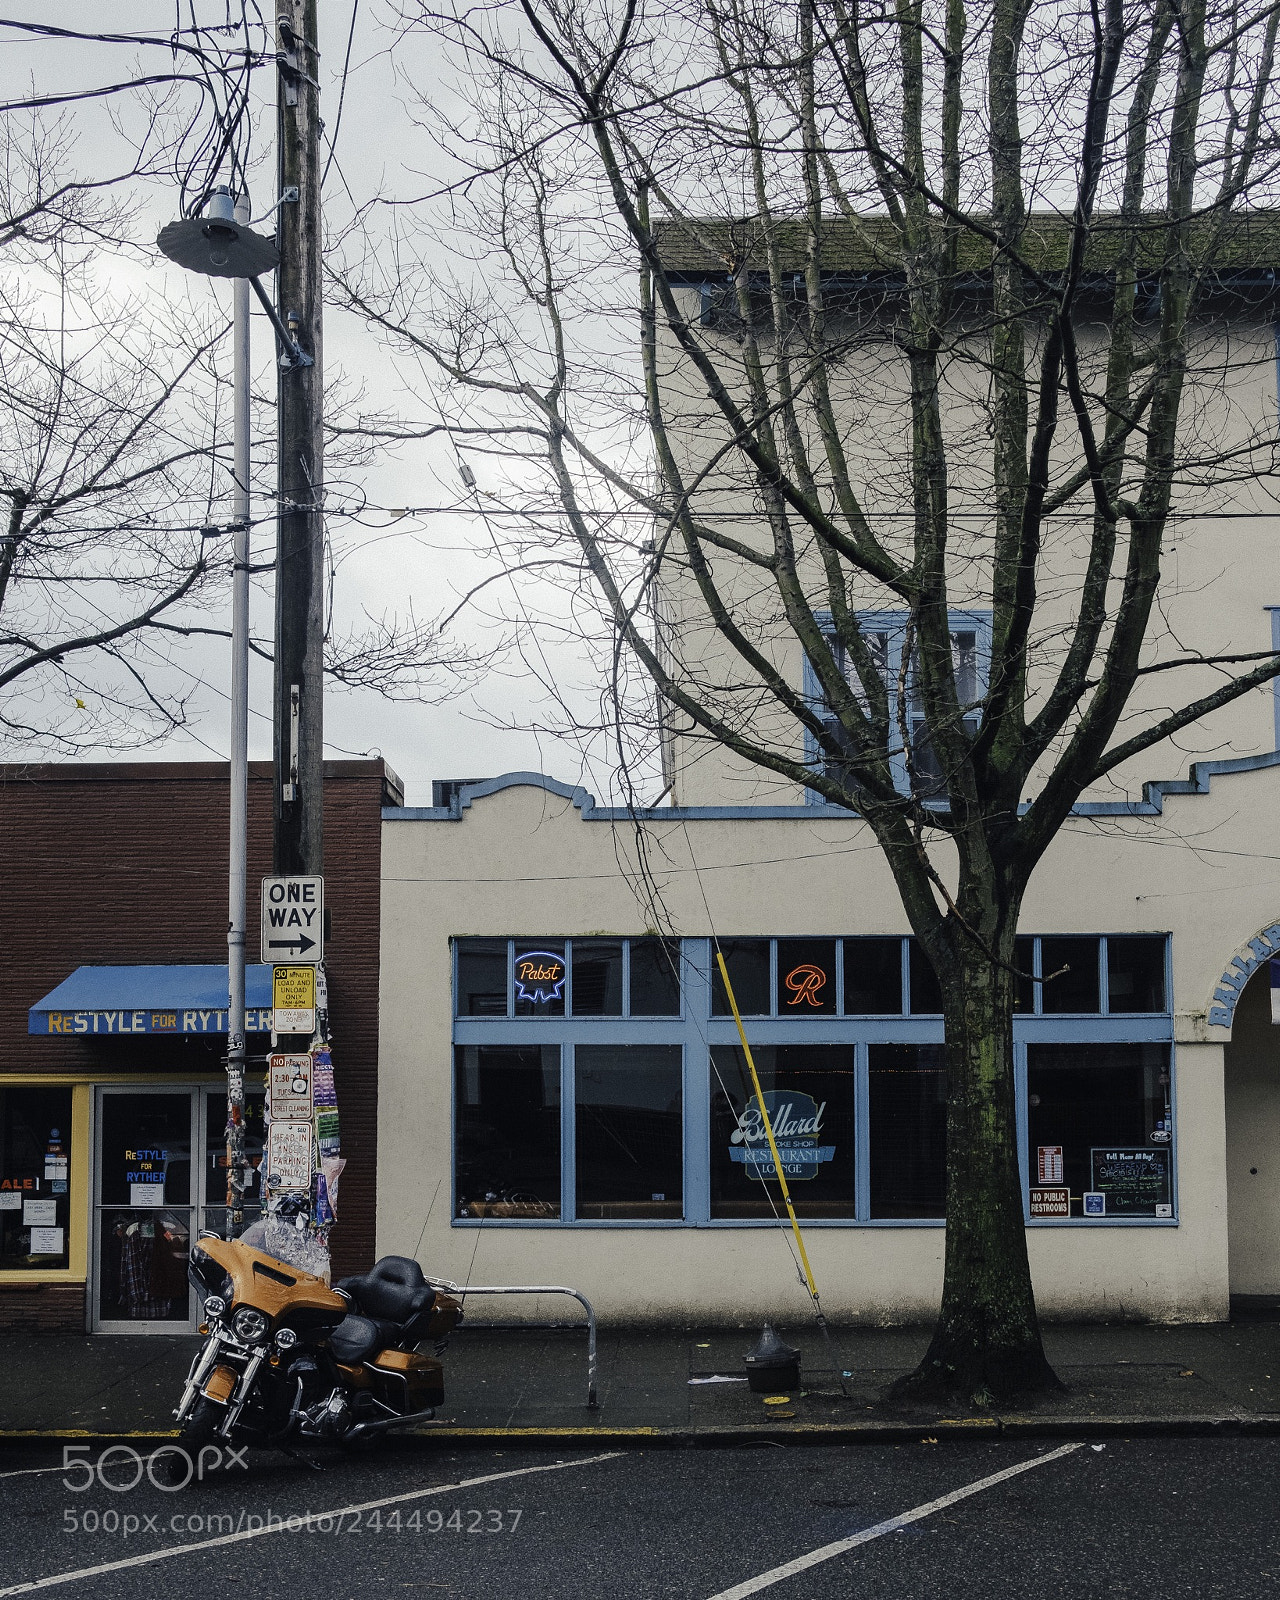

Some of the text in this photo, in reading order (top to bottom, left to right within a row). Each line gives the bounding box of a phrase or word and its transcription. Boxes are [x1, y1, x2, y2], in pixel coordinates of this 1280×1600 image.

[269, 883, 316, 903] ONE
[268, 908, 317, 927] WAY
[275, 969, 287, 978] 30
[520, 962, 560, 980] Pabst
[785, 964, 827, 1006] R
[151, 1013, 177, 1028] FOR
[183, 1009, 273, 1031] RYTER
[273, 1157, 307, 1165] PARKING
[762, 1164, 802, 1173] LONGE
[127, 1172, 166, 1182] RYTHER
[1032, 1192, 1065, 1202] NO PUBLIC
[1030, 1203, 1068, 1213] RESTROOMS
